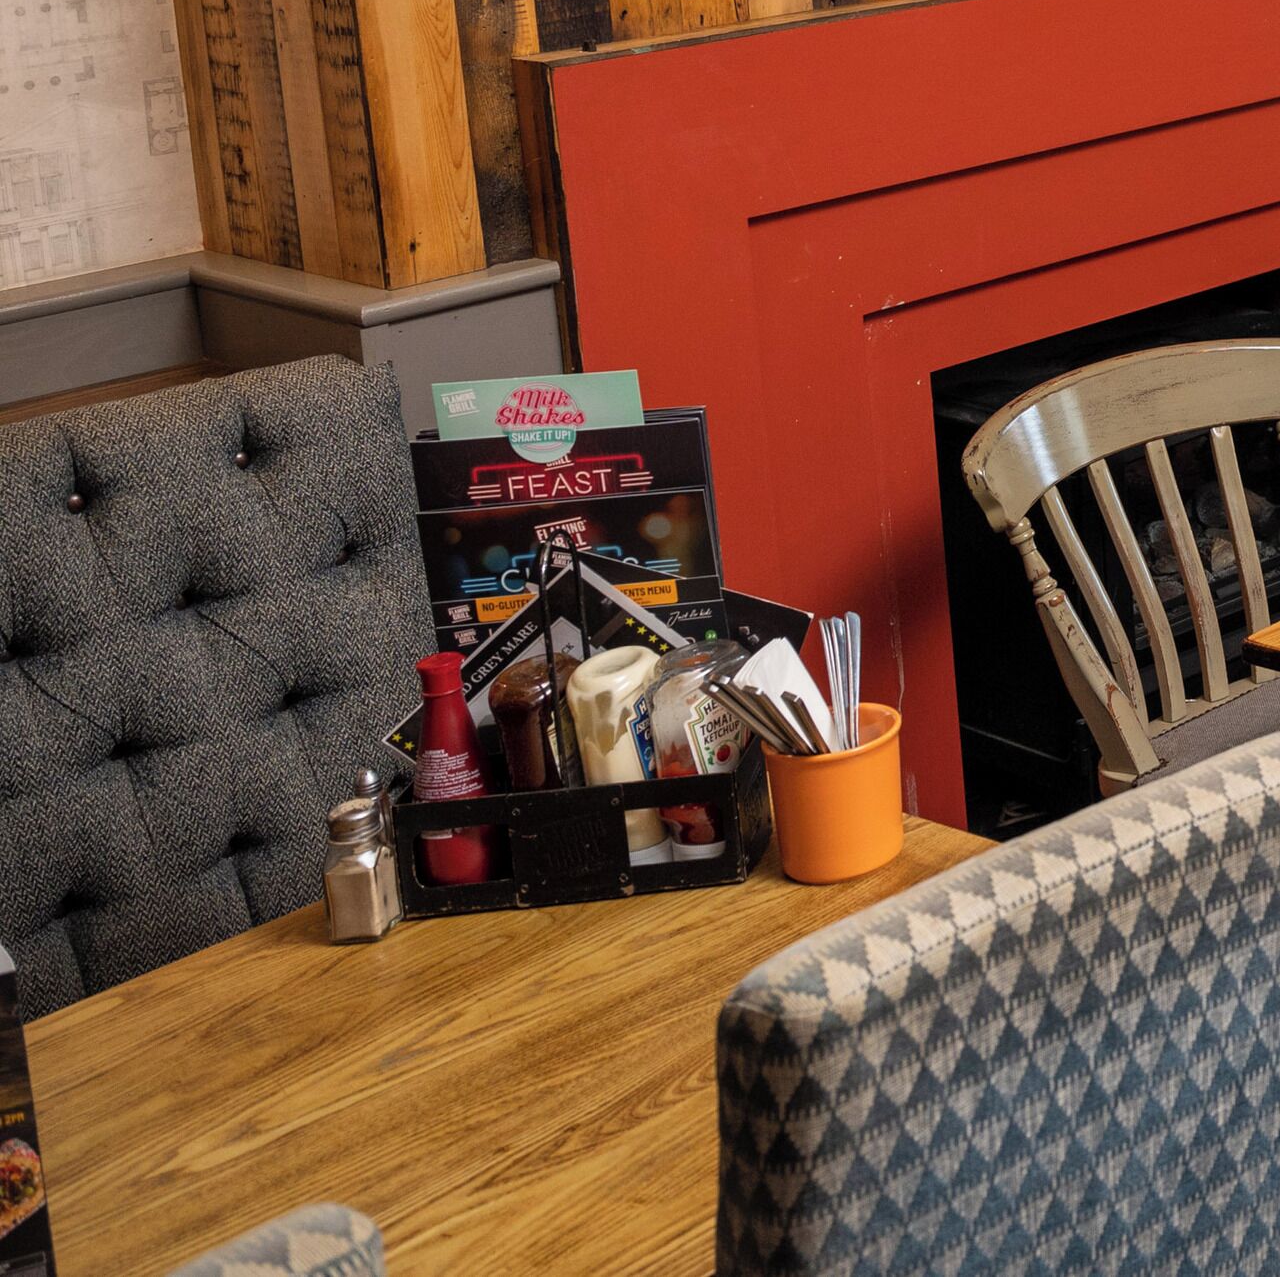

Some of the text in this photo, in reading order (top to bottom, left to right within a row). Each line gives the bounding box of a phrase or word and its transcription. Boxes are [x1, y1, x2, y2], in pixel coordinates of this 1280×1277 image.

[442, 392, 477, 405] FLAMING
[448, 401, 476, 414] GRILL
[513, 388, 570, 408] Milk
[496, 405, 586, 426] Shakes
[511, 430, 571, 443] SHAKE IT UP!
[508, 468, 612, 500] FEAST
[647, 585, 672, 596] MENU
[470, 621, 538, 684] GREY MARE
[700, 711, 734, 735] TOMAT
[703, 720, 741, 746] KETCHUP
